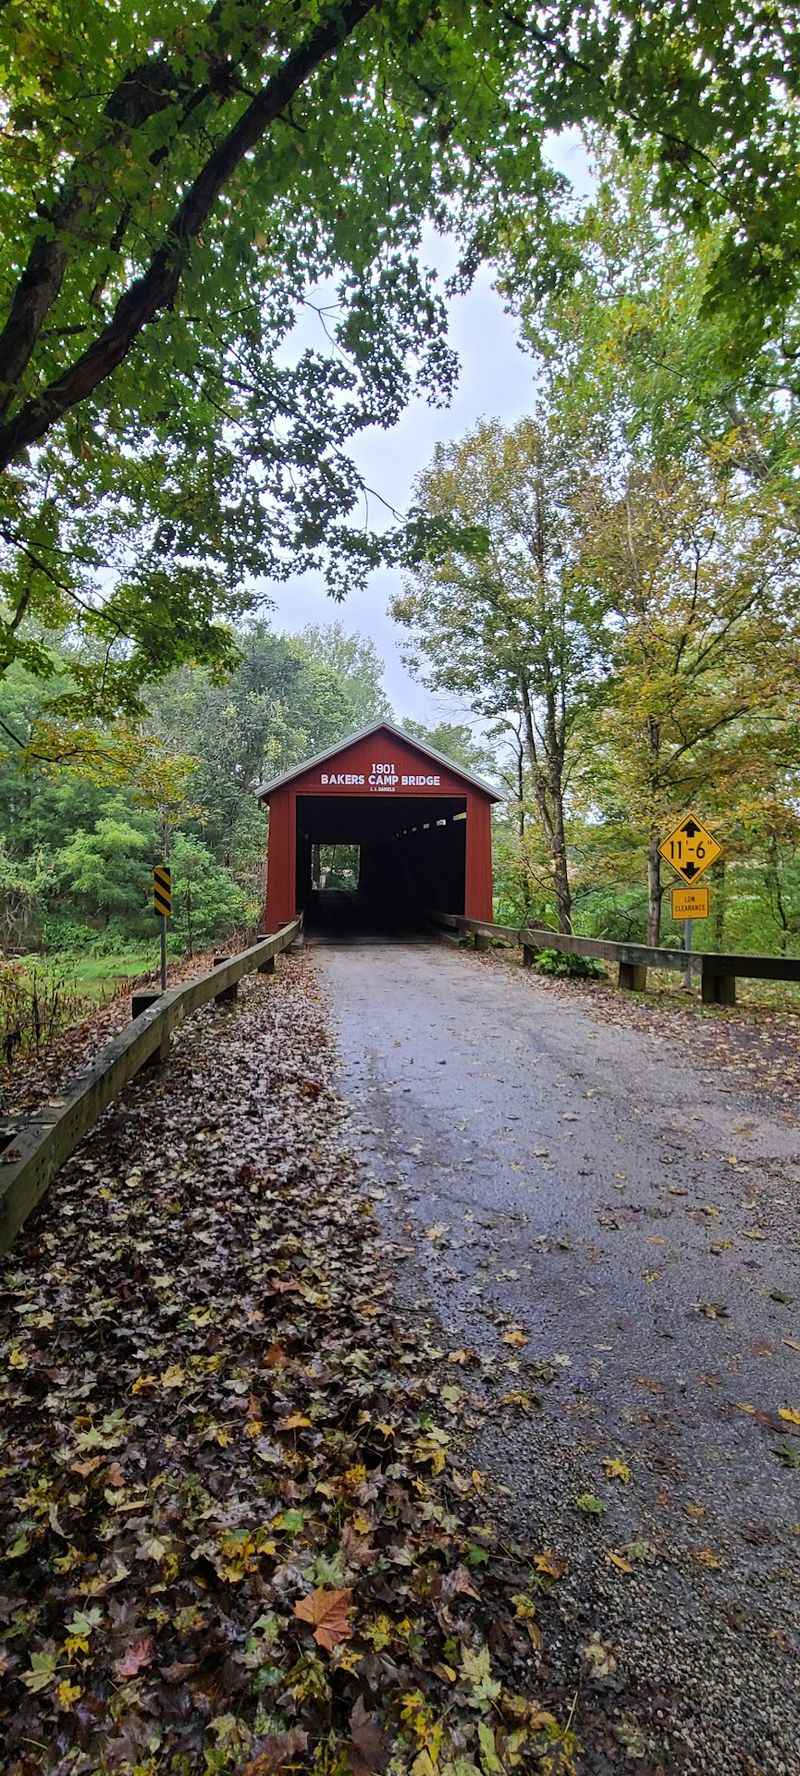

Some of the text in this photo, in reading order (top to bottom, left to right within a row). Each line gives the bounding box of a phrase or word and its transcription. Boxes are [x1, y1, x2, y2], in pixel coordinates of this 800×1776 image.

[371, 763, 396, 774] 1901
[321, 774, 441, 786] BAKERS CAMP BRIDGE
[675, 904, 705, 912] CLEARANCE
